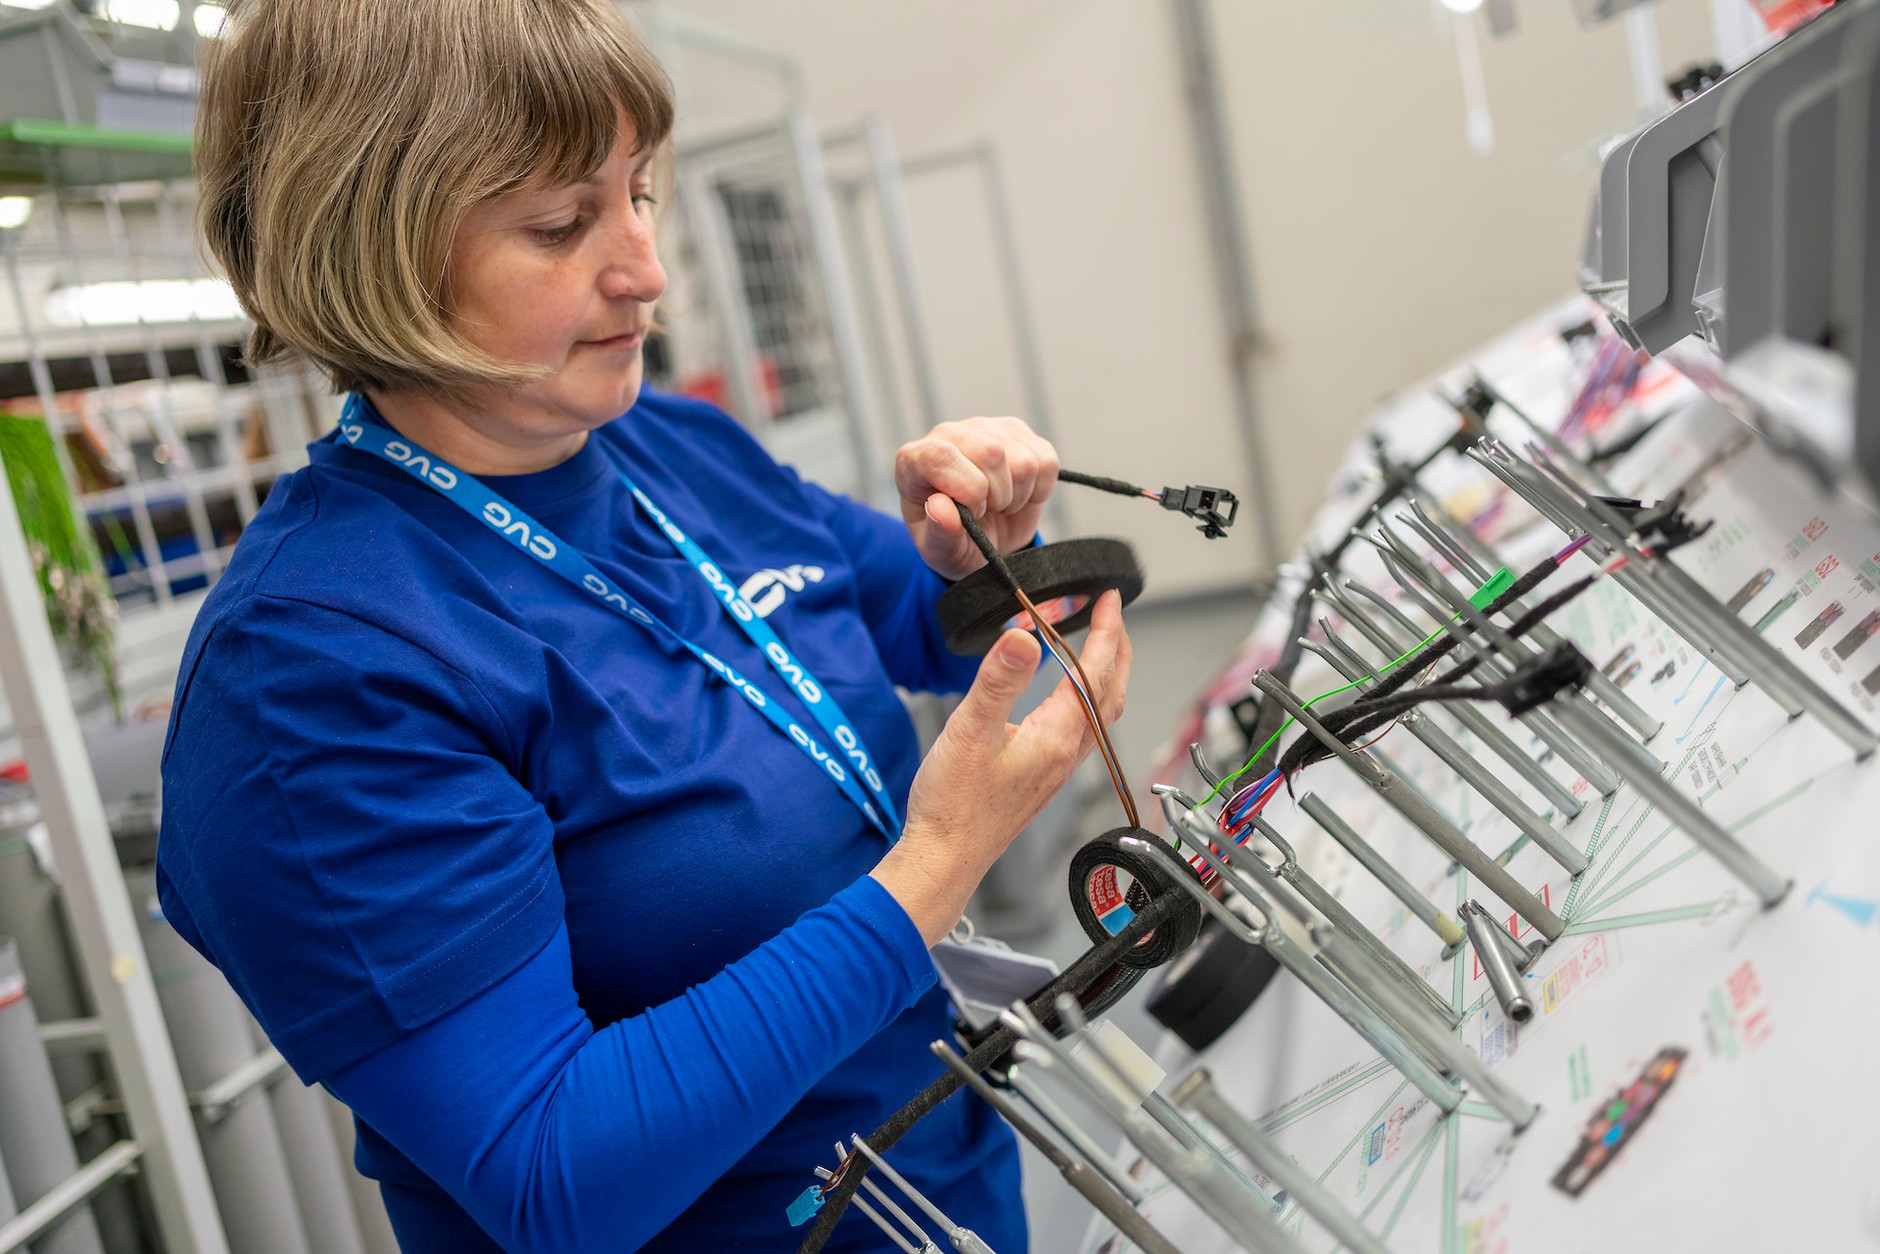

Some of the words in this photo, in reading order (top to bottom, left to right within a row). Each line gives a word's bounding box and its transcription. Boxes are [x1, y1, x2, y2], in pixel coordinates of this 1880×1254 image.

[384, 441, 458, 490] CVG
[483, 501, 557, 560] CVG
[582, 573, 654, 625] CVG
[699, 561, 753, 621] CVG
[702, 652, 766, 707] CVG
[766, 641, 823, 704] CVG
[788, 723, 846, 782] CVG
[834, 724, 883, 793] CVG
[1096, 868, 1106, 905] tesa
[1104, 866, 1116, 898] tesa
